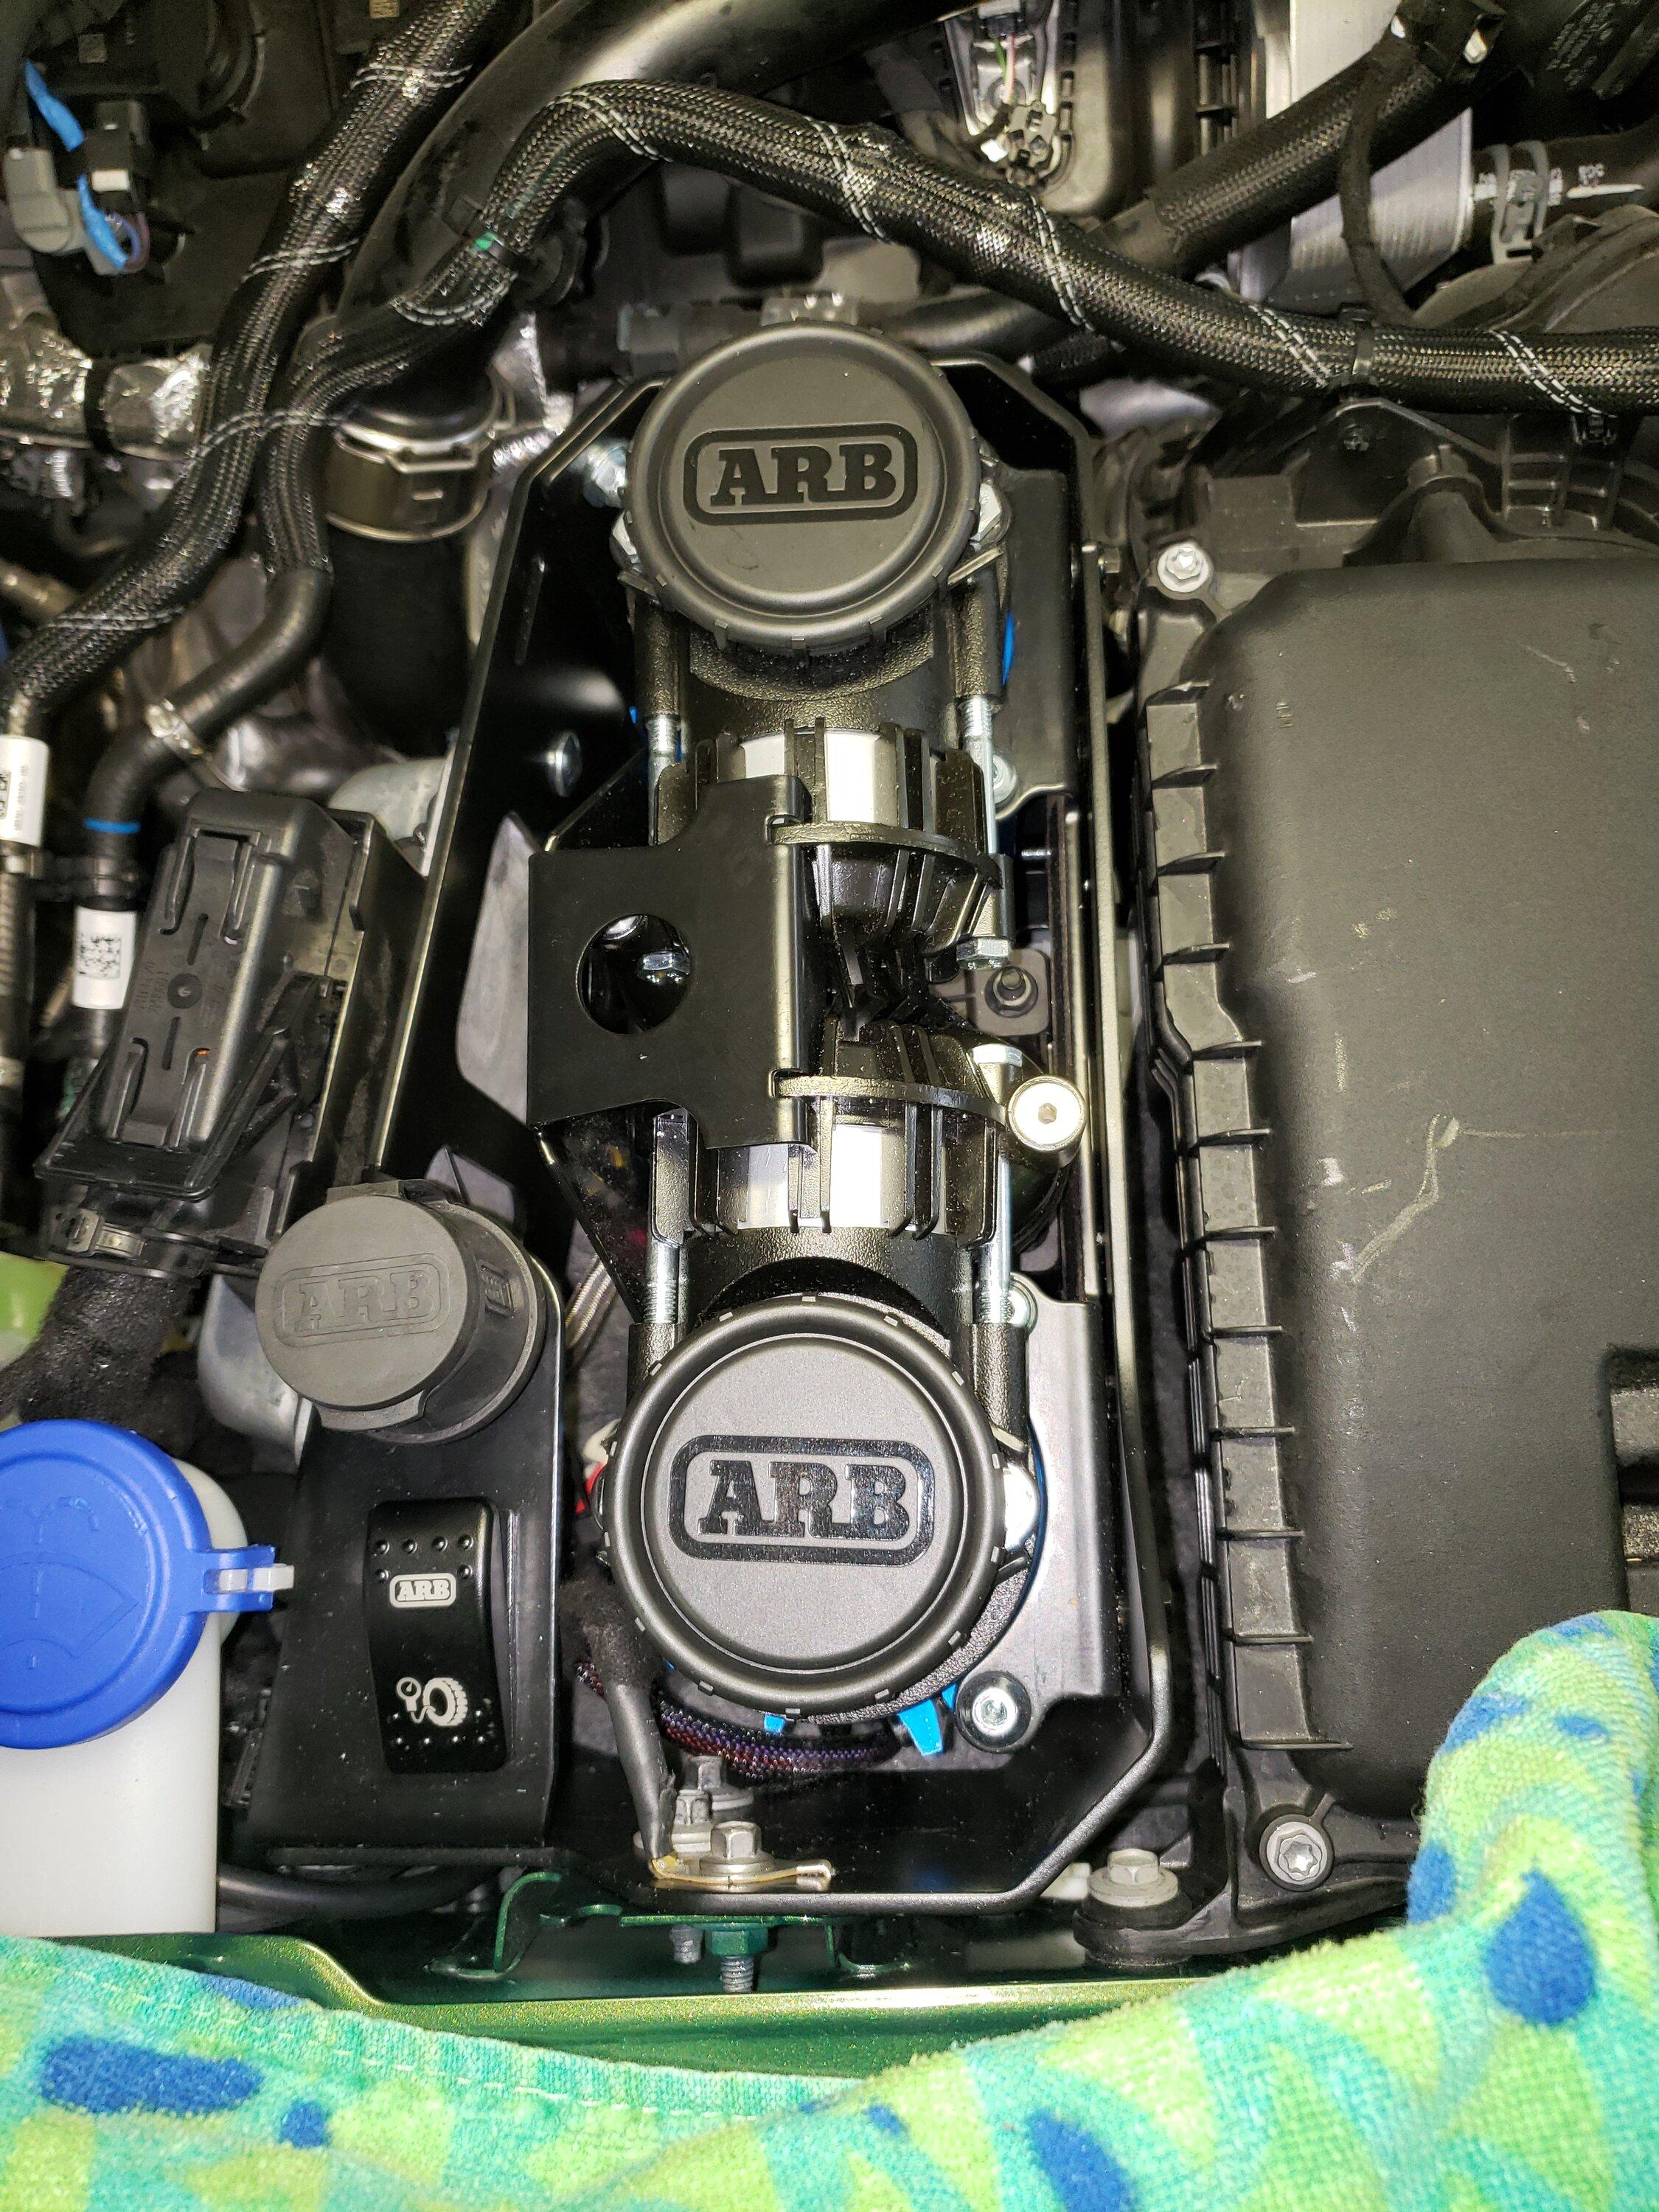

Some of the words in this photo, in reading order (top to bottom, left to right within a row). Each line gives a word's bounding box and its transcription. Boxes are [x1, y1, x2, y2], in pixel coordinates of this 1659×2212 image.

[710, 443, 897, 507] ARB
[293, 1269, 434, 1332] ARB
[698, 1460, 911, 1541] ARB
[397, 1579, 451, 1601] ARB
